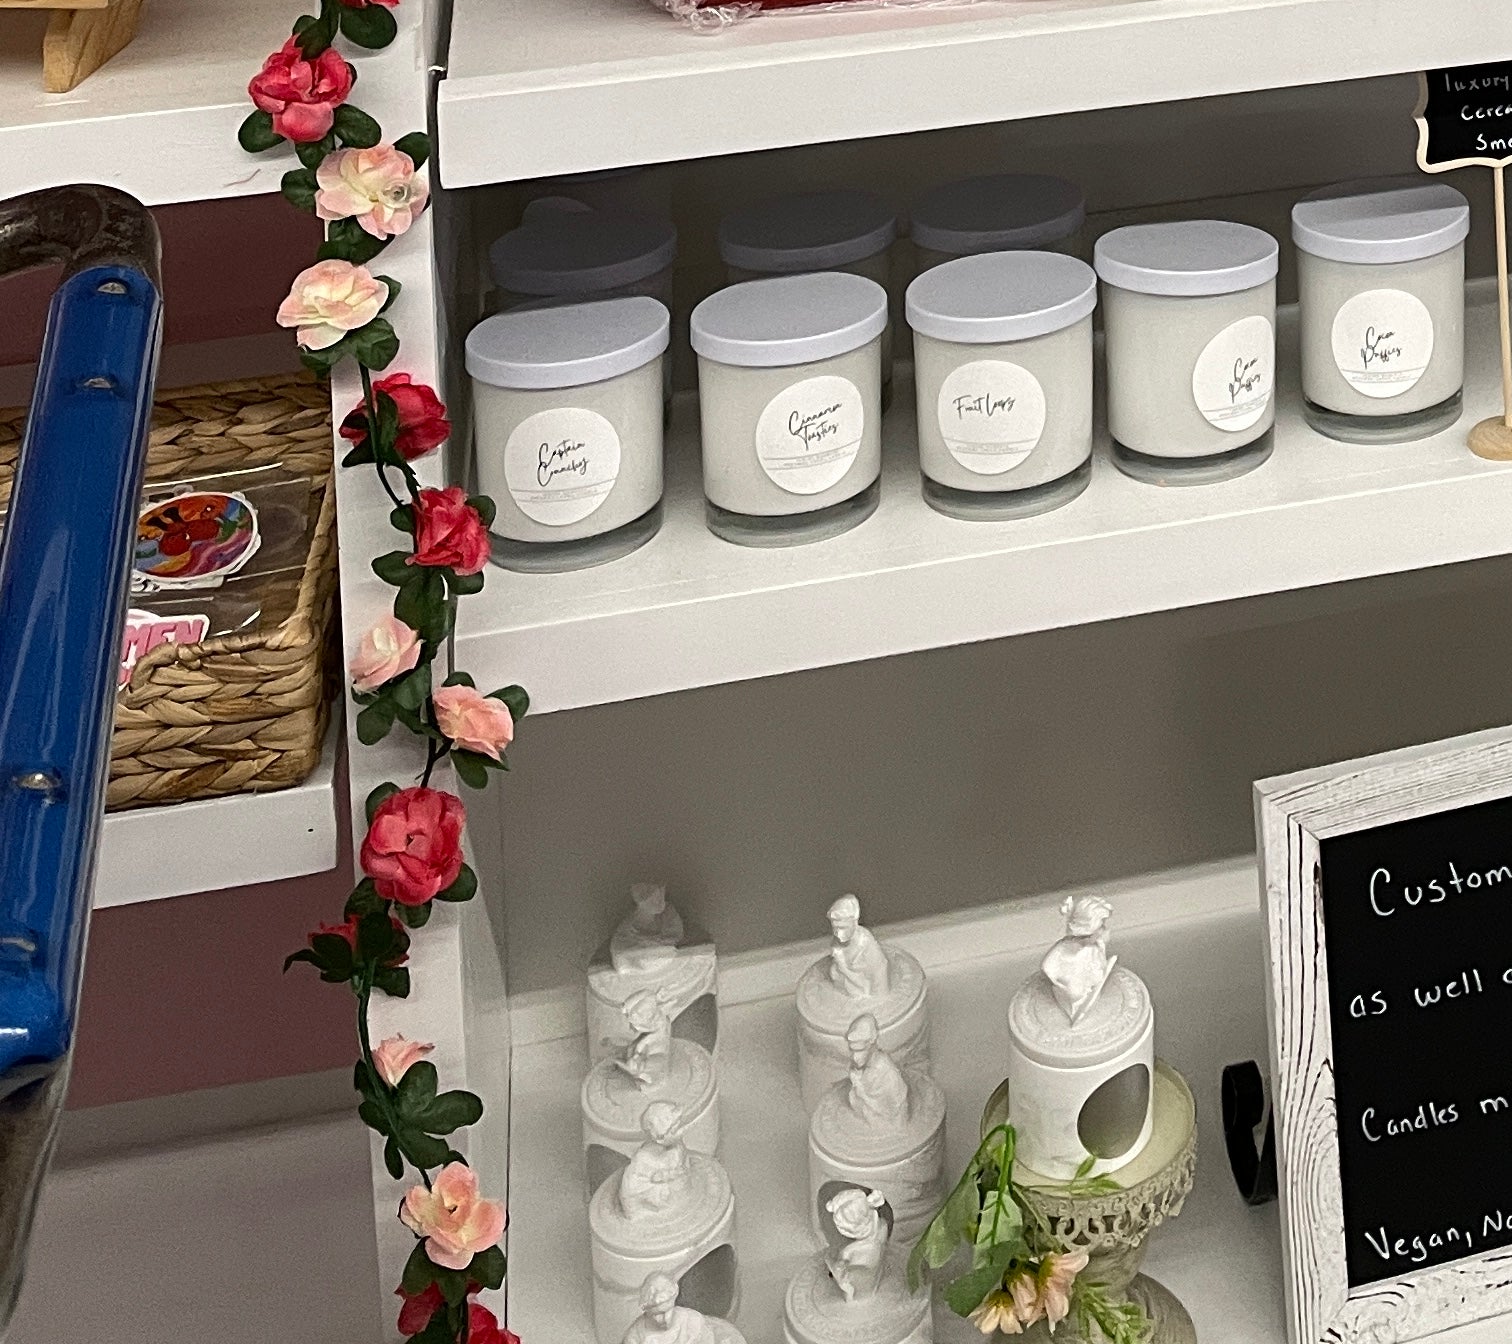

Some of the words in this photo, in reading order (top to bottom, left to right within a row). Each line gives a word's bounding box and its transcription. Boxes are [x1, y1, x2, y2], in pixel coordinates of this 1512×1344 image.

[1444, 72, 1511, 95] luxury
[789, 403, 843, 436] Cinnamon
[952, 395, 986, 421] Fruit
[1349, 989, 1389, 1020] as
[1413, 968, 1484, 1009] well
[1361, 1103, 1461, 1144] Candles
[1364, 1225, 1473, 1263] Vegan,
